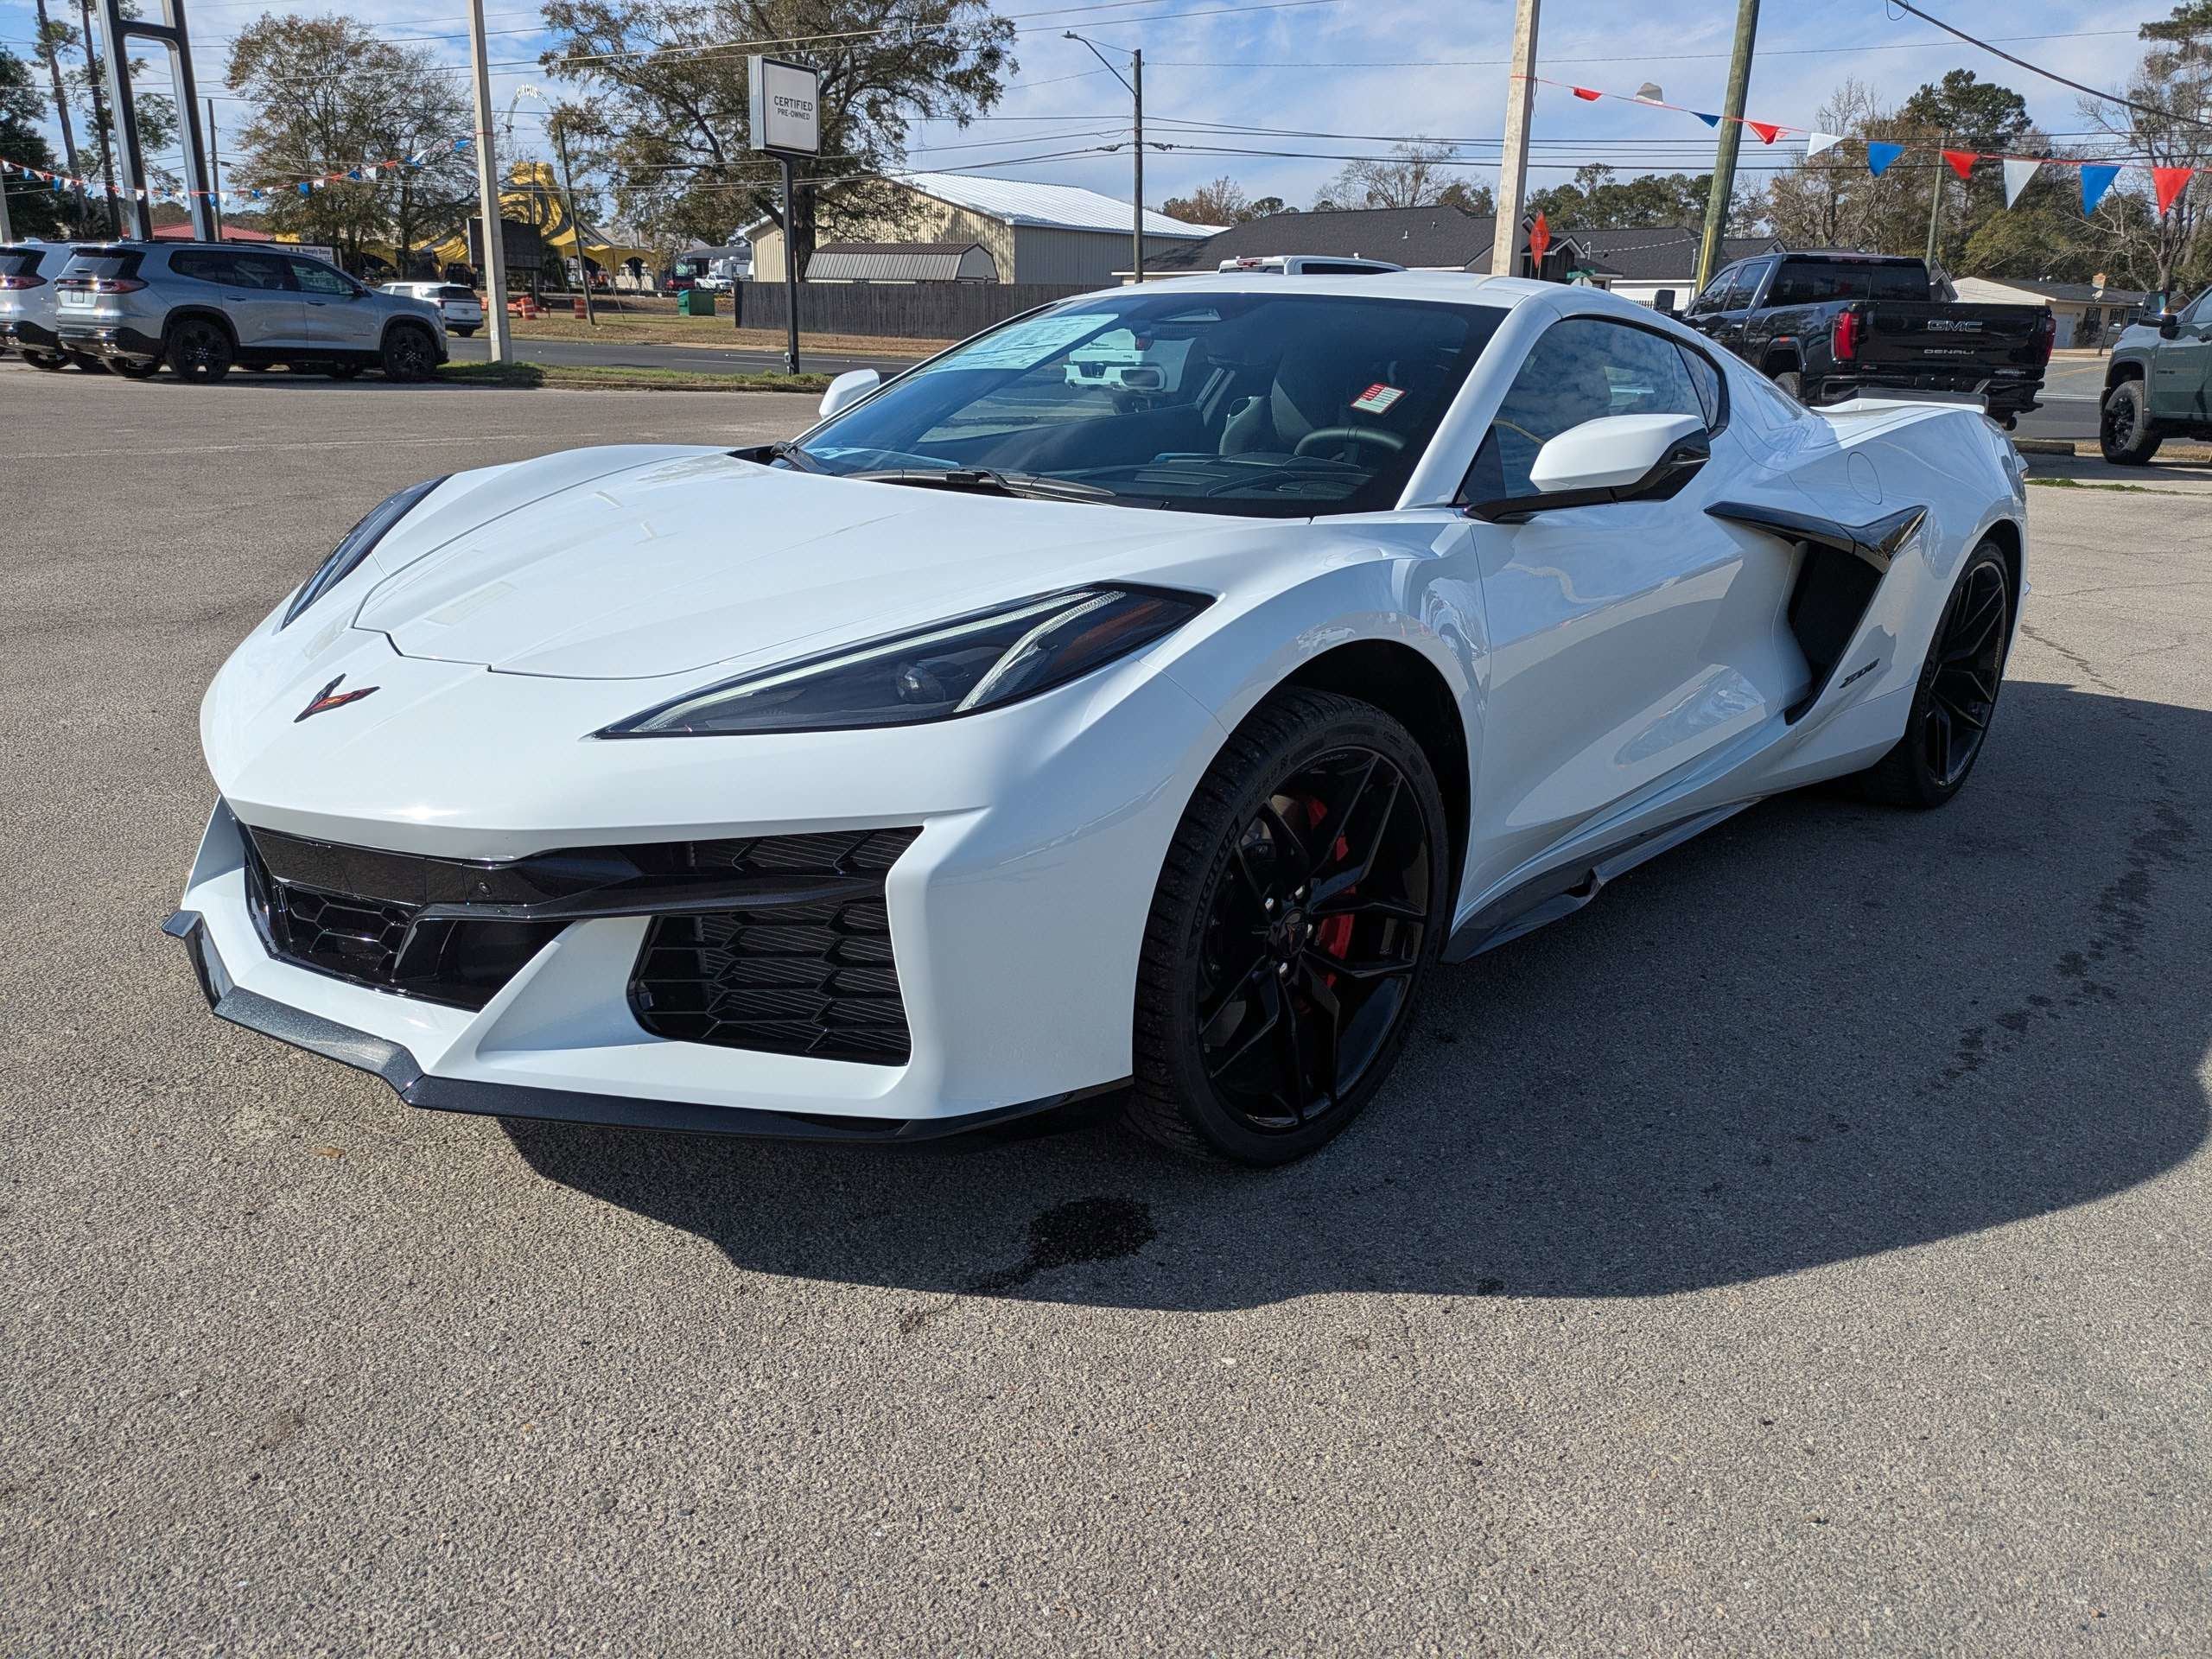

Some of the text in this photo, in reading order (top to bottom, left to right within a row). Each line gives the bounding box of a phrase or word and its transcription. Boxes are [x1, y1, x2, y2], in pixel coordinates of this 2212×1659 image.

[517, 83, 538, 99] CIRCUS
[774, 95, 813, 111] CERTIFIED
[778, 108, 810, 120] PRE-OWNED
[1928, 320, 1982, 333] GMC
